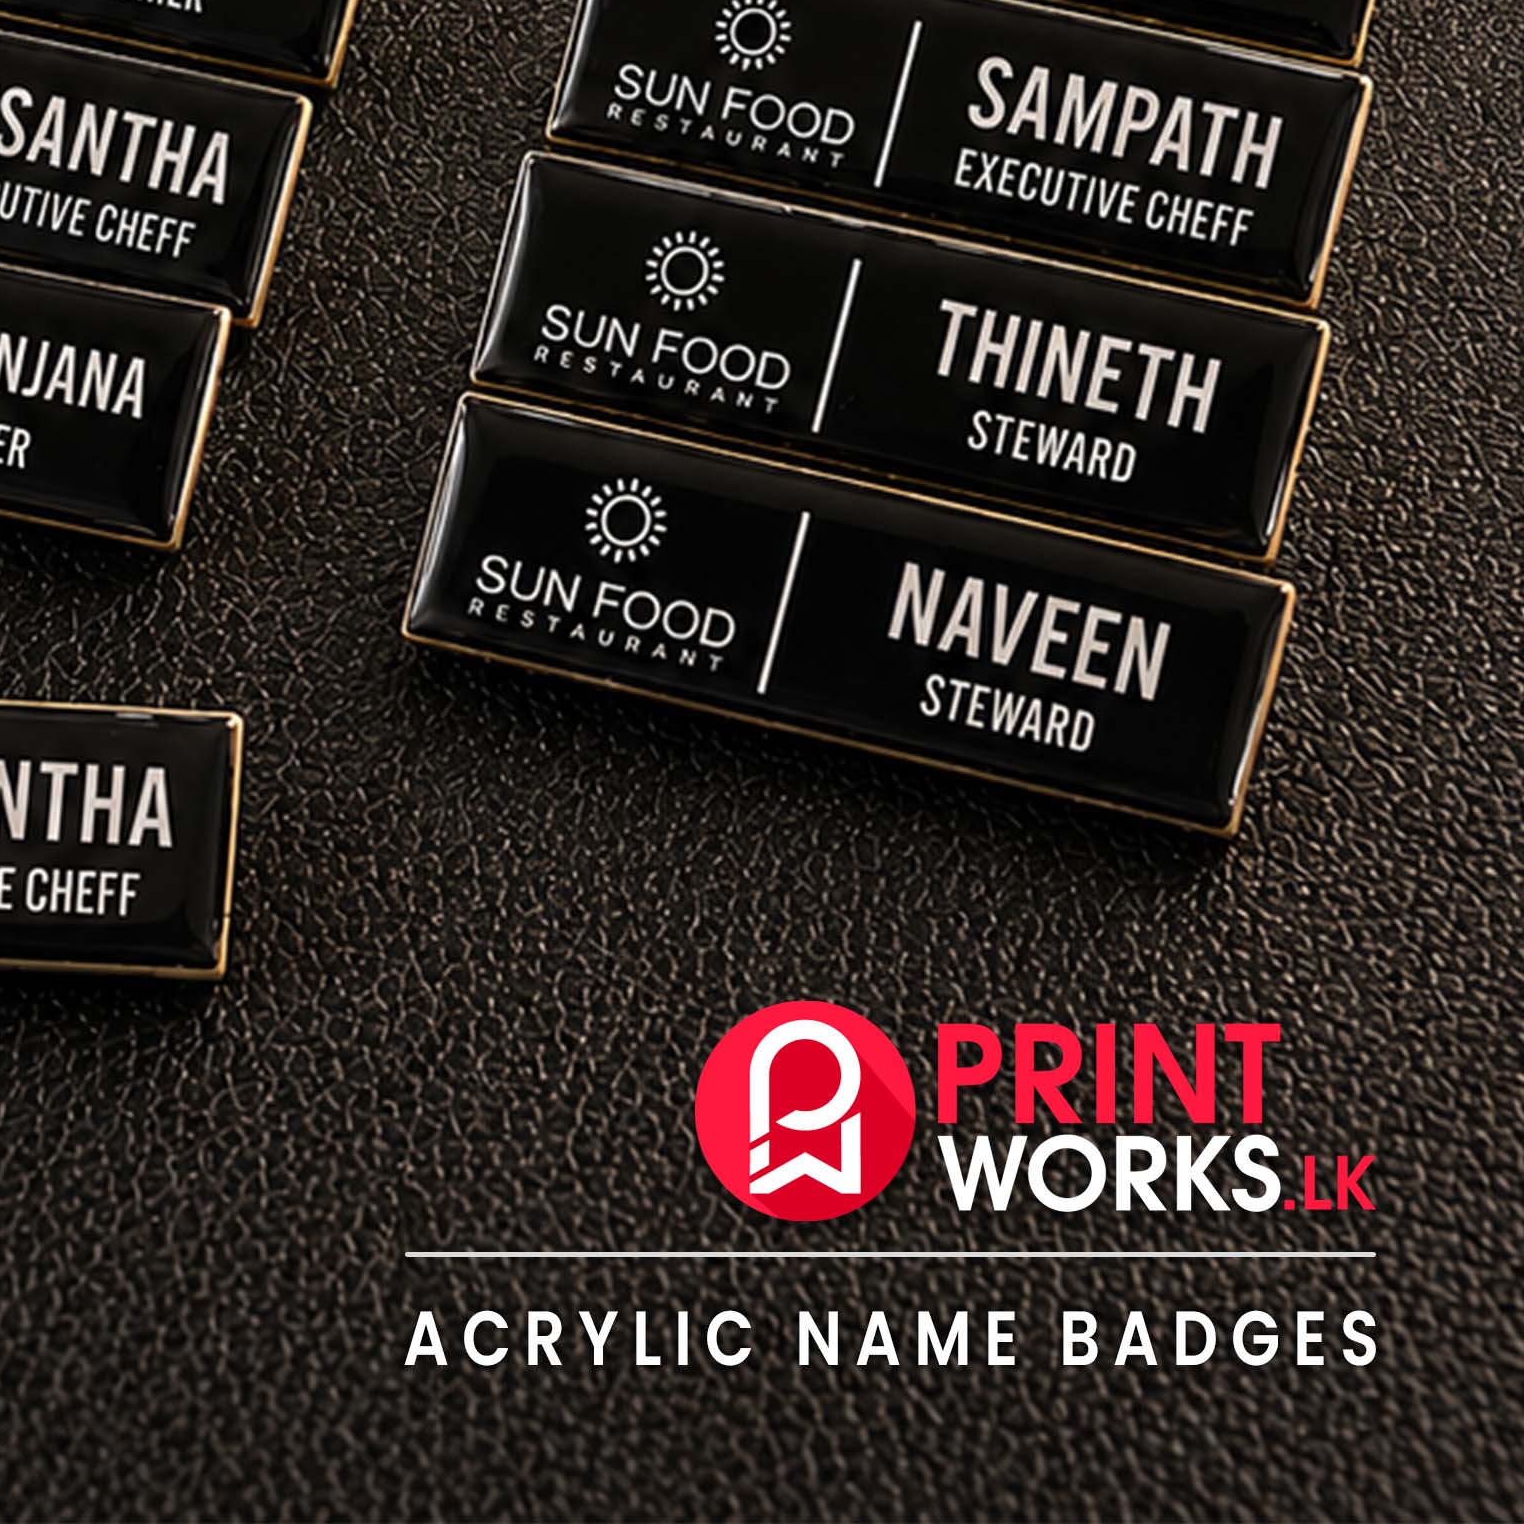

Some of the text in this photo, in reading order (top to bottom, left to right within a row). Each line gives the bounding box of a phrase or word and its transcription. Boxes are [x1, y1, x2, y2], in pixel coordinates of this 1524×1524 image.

[608, 102, 846, 168] RESTAURANT
[614, 64, 854, 146] SUN FOOD
[967, 56, 1282, 189] SAMPATH
[94, 201, 196, 259] CHEFF
[955, 148, 1255, 248] EXECUTIVE CHEFF
[534, 345, 780, 414] RESTAURANT
[541, 303, 790, 390] SUN FOOD
[936, 298, 1222, 434] THINETH
[967, 410, 1137, 483] STEWARD
[468, 599, 724, 673] RESTAURANT
[475, 554, 735, 648] SUN FOOD
[887, 562, 1171, 701] NAVEEN
[920, 675, 1095, 753] STEWARD
[25, 867, 140, 917] CHEFF
